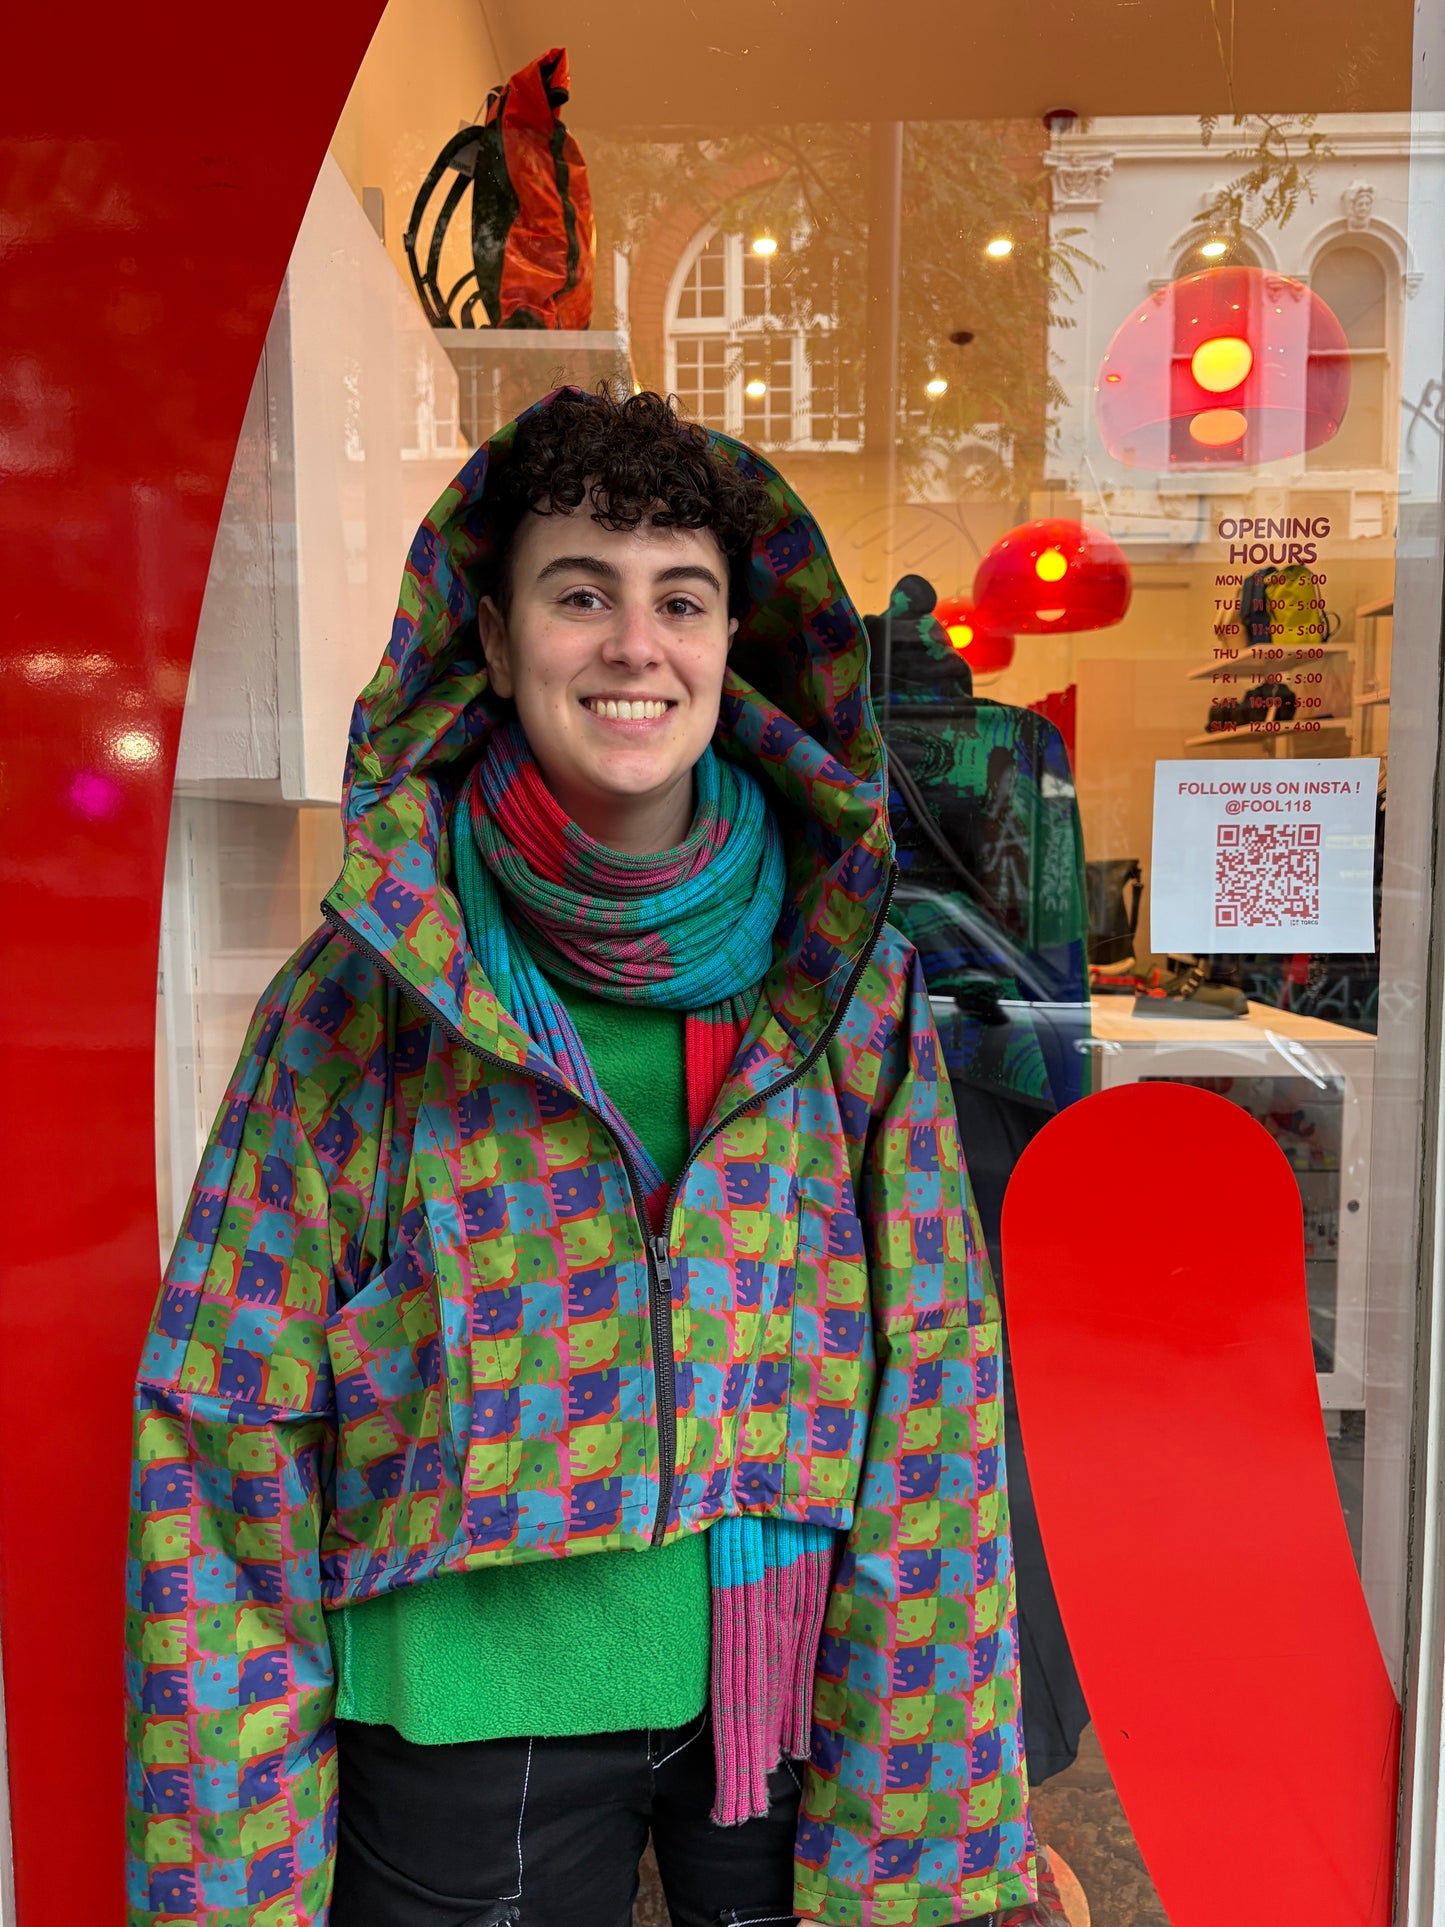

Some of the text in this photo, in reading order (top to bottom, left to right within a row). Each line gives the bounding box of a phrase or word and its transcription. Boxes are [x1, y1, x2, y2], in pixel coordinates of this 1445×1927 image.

[1218, 517, 1331, 540] OPENING
[1229, 542, 1318, 565] HOURS
[1215, 575, 1243, 586] MON
[1254, 574, 1286, 586] 11:00
[1298, 574, 1327, 586] 5:00
[1214, 599, 1241, 611] TUE
[1253, 599, 1285, 611] 1100
[1297, 599, 1326, 611] 5:00
[1213, 624, 1240, 636] WED
[1252, 623, 1284, 636] 11:00
[1296, 623, 1325, 636] 5:00
[1213, 648, 1239, 659] THU
[1251, 648, 1284, 659] 11:00
[1295, 648, 1324, 659] 5:00
[1212, 673, 1238, 684] FRI
[1294, 673, 1323, 684] 5:00
[1211, 697, 1237, 709] SAT
[1294, 697, 1322, 709] 5:00
[1210, 721, 1238, 733] SUN
[1249, 721, 1281, 733] 12:00
[1293, 721, 1321, 732] 4:00
[1178, 782, 1247, 795] FOLLOW
[1250, 781, 1272, 795] US
[1276, 781, 1300, 795] ON
[1303, 781, 1352, 794] INSTA
[1225, 799, 1312, 816] @FOOL118
